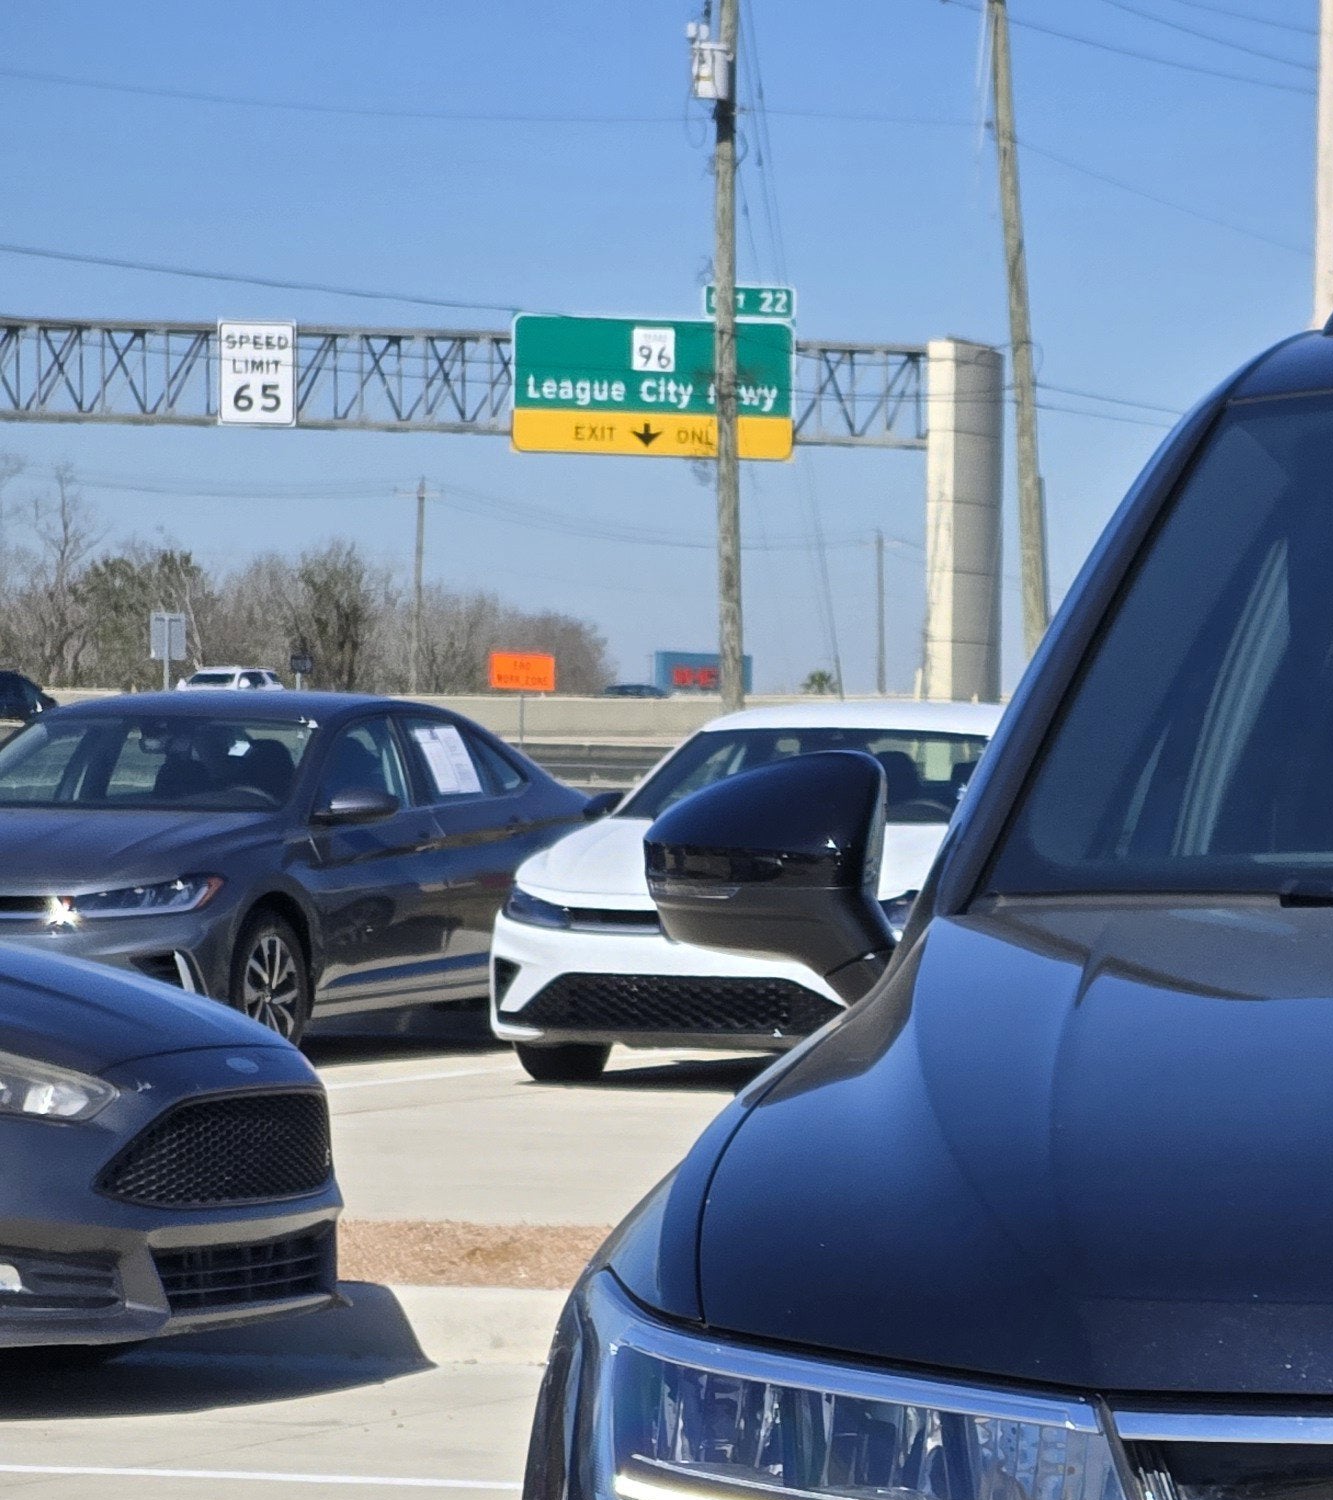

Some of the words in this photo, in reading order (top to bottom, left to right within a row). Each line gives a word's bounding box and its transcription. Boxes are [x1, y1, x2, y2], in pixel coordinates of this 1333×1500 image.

[758, 290, 788, 313] 22
[225, 333, 289, 350] SPEED
[232, 358, 281, 375] LIMIT
[638, 345, 671, 369] 96
[233, 383, 281, 413] 65
[526, 374, 626, 406] League
[640, 377, 694, 410] City
[574, 424, 616, 442] EXIT
[676, 429, 715, 446] ONL
